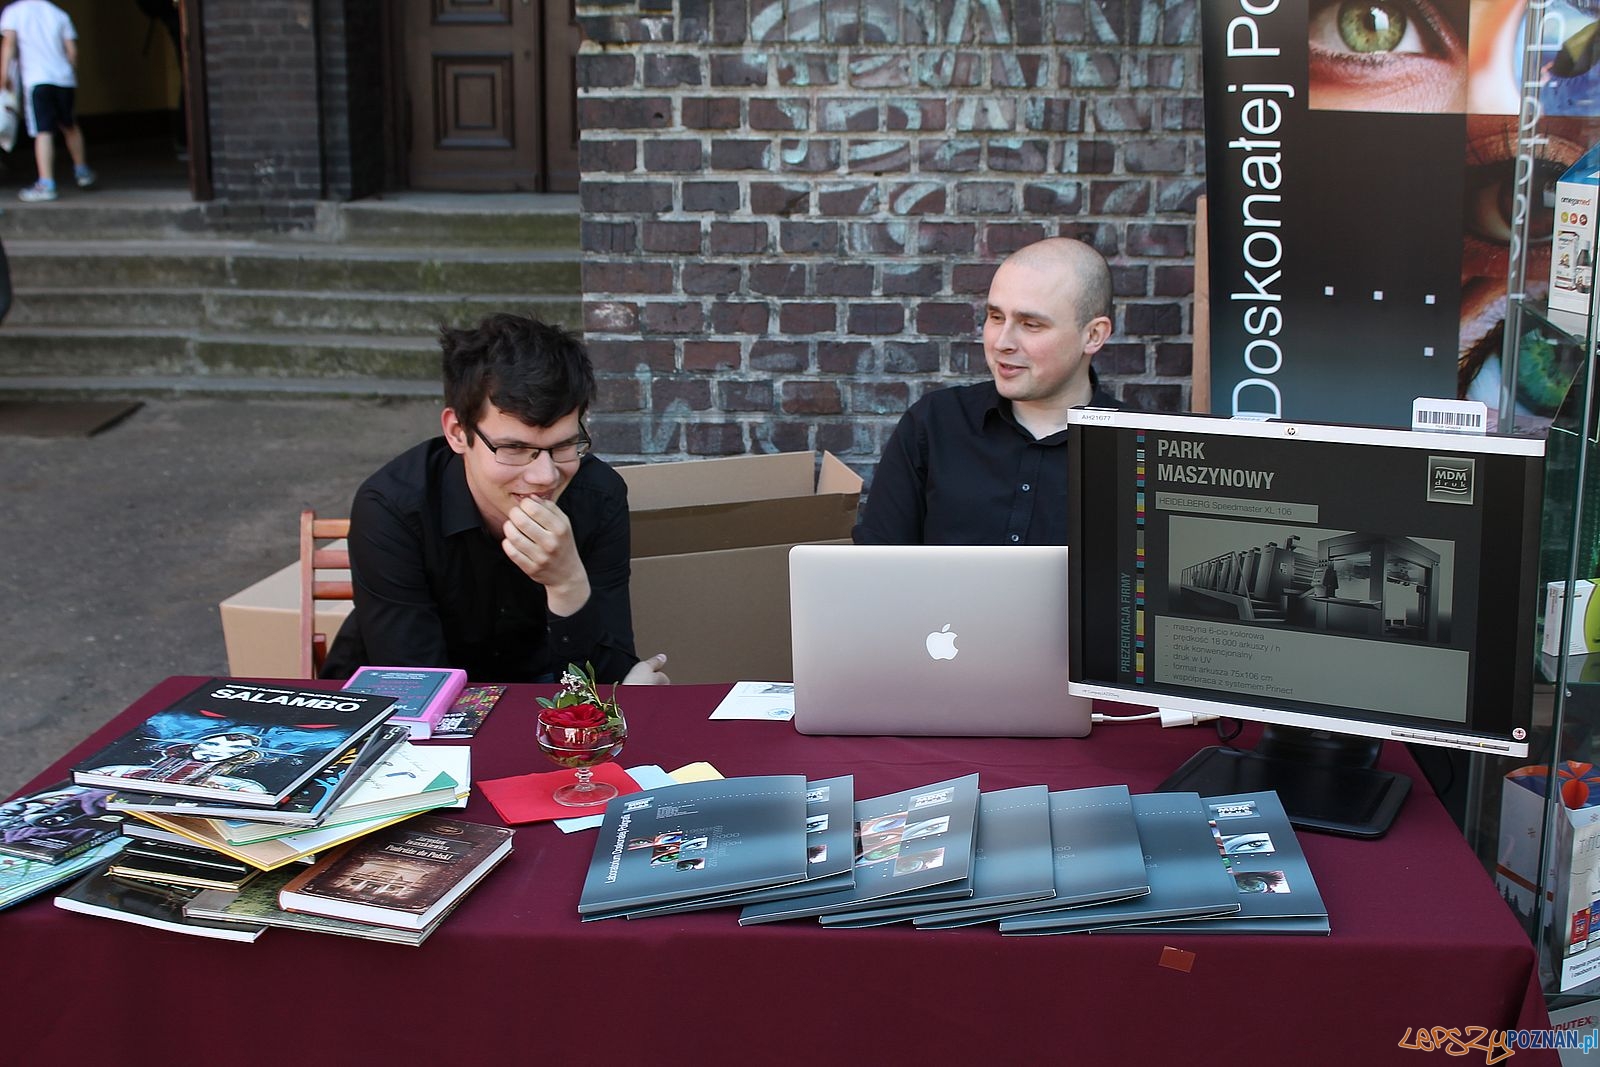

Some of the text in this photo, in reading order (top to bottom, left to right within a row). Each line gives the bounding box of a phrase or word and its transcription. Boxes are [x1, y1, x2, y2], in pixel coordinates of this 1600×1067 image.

[1228, 83, 1295, 419] Doskonałej
[1158, 439, 1205, 460] PARK
[1158, 464, 1275, 490] MASZYNOWY
[1435, 470, 1466, 481] MDM
[1159, 497, 1292, 516] HEIDELBERG Speedmaster XL 106
[1121, 572, 1131, 672] PREZENTACJA FIRMY
[1173, 623, 1206, 634] maszyna
[1230, 629, 1265, 641] kolorowa
[1173, 644, 1253, 660] druk konwencjonalny
[1239, 642, 1268, 652] arkuszy
[1173, 663, 1197, 672] format
[1199, 667, 1229, 676] arkusza
[1225, 680, 1264, 691] systemem
[210, 688, 361, 712] SALAMBO
